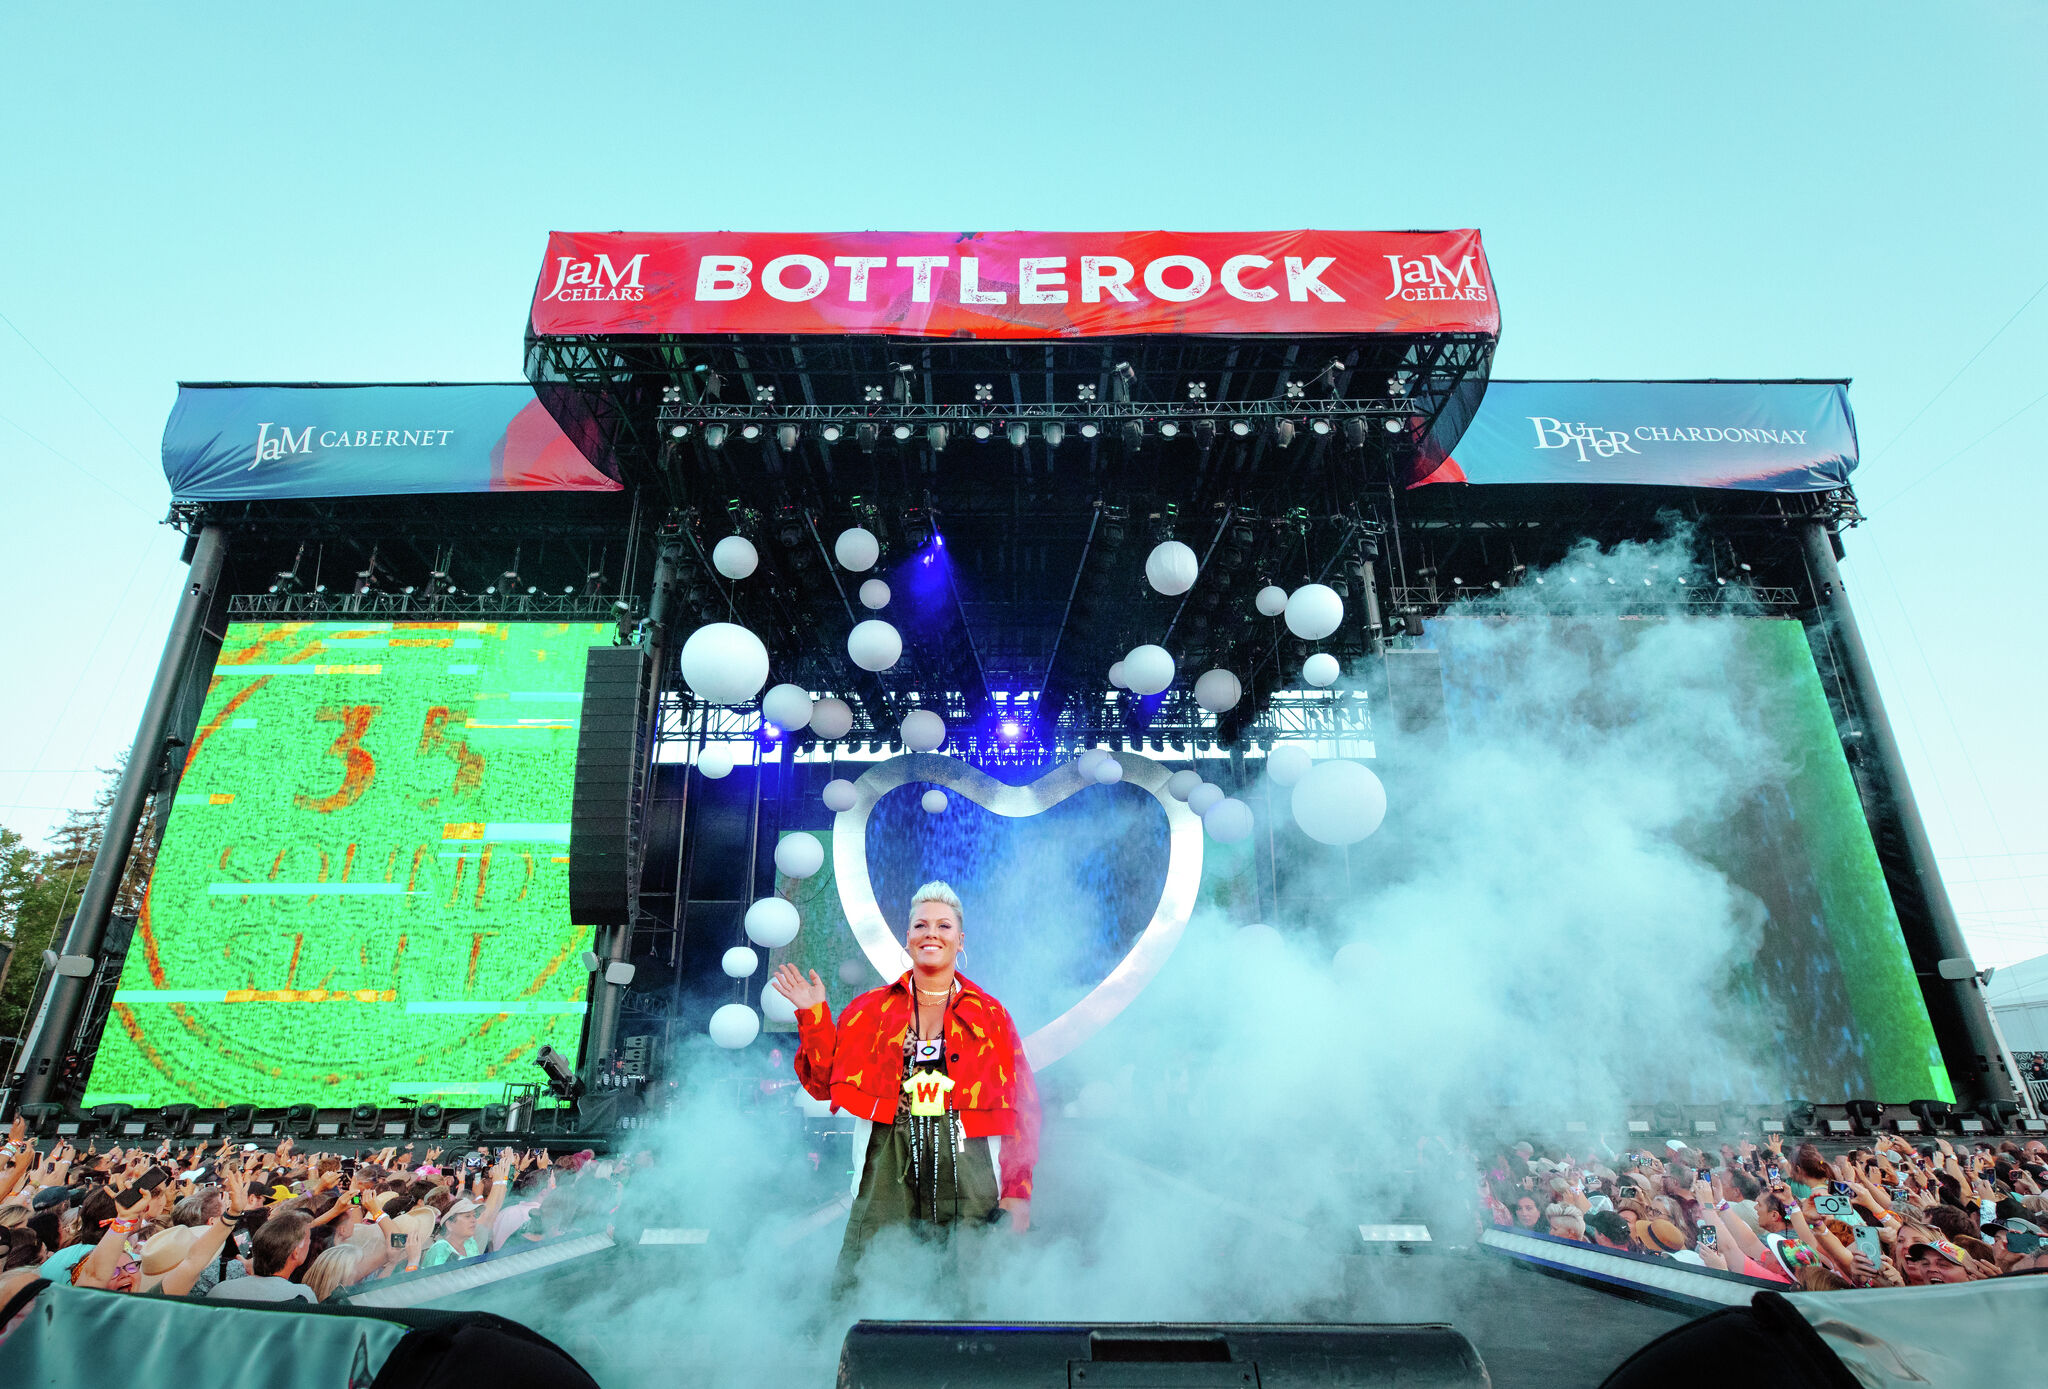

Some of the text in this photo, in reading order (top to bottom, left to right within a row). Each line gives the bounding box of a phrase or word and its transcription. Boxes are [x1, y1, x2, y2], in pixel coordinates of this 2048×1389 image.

[695, 254, 1346, 305] BOTTLEROCK
[557, 288, 644, 301] CELLARS
[1401, 287, 1488, 301] CELLARS
[320, 428, 453, 447] CABERNET
[1634, 425, 1808, 447] CHARDONNAY
[917, 1082, 940, 1103] W
